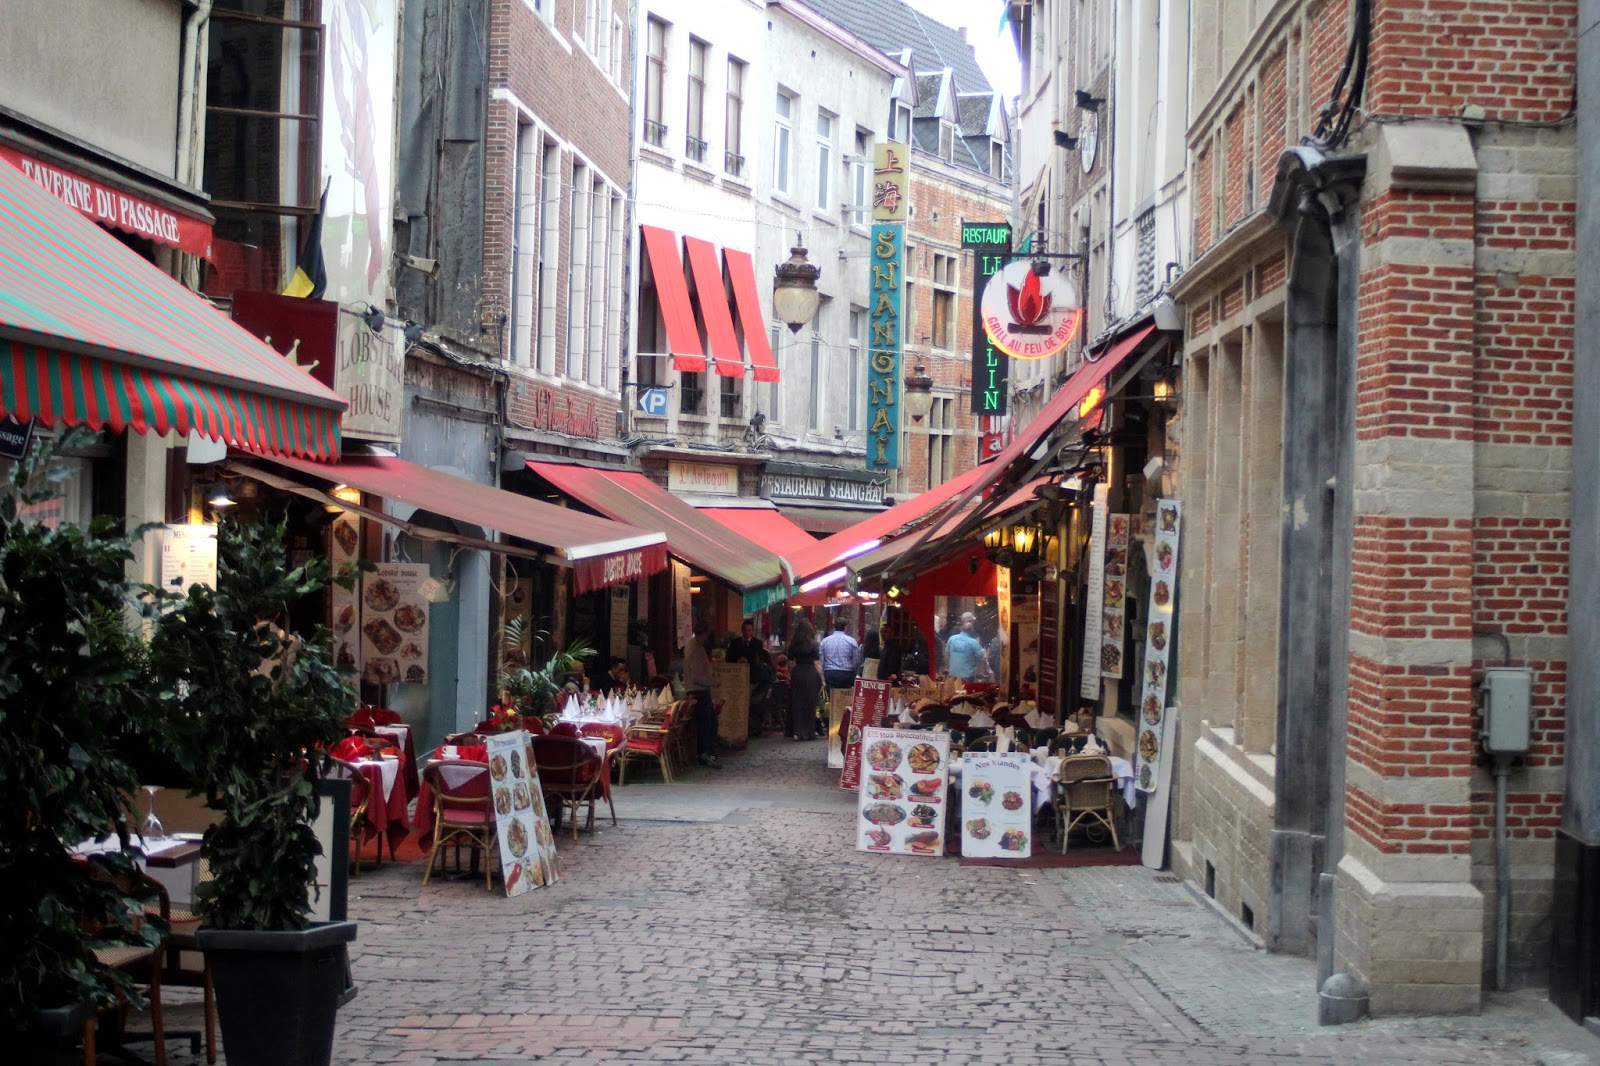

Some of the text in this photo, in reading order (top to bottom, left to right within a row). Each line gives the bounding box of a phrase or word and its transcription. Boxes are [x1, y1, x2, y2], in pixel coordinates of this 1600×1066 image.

[873, 149, 904, 214] 上海
[22, 159, 180, 243] TAVERNE DU PASSAGE
[962, 227, 1007, 244] RESTAUR
[869, 230, 898, 465] SHANGHAI
[987, 316, 1073, 353] GRILL AU FEU DE BOIS
[340, 332, 401, 384] LOBSTER
[349, 382, 392, 422] HOUSE
[650, 393, 665, 413] P
[829, 480, 882, 503] SHANGHAI
[604, 551, 643, 583] LOBSTER HOUSE
[975, 759, 1020, 771] Nos Viandes
